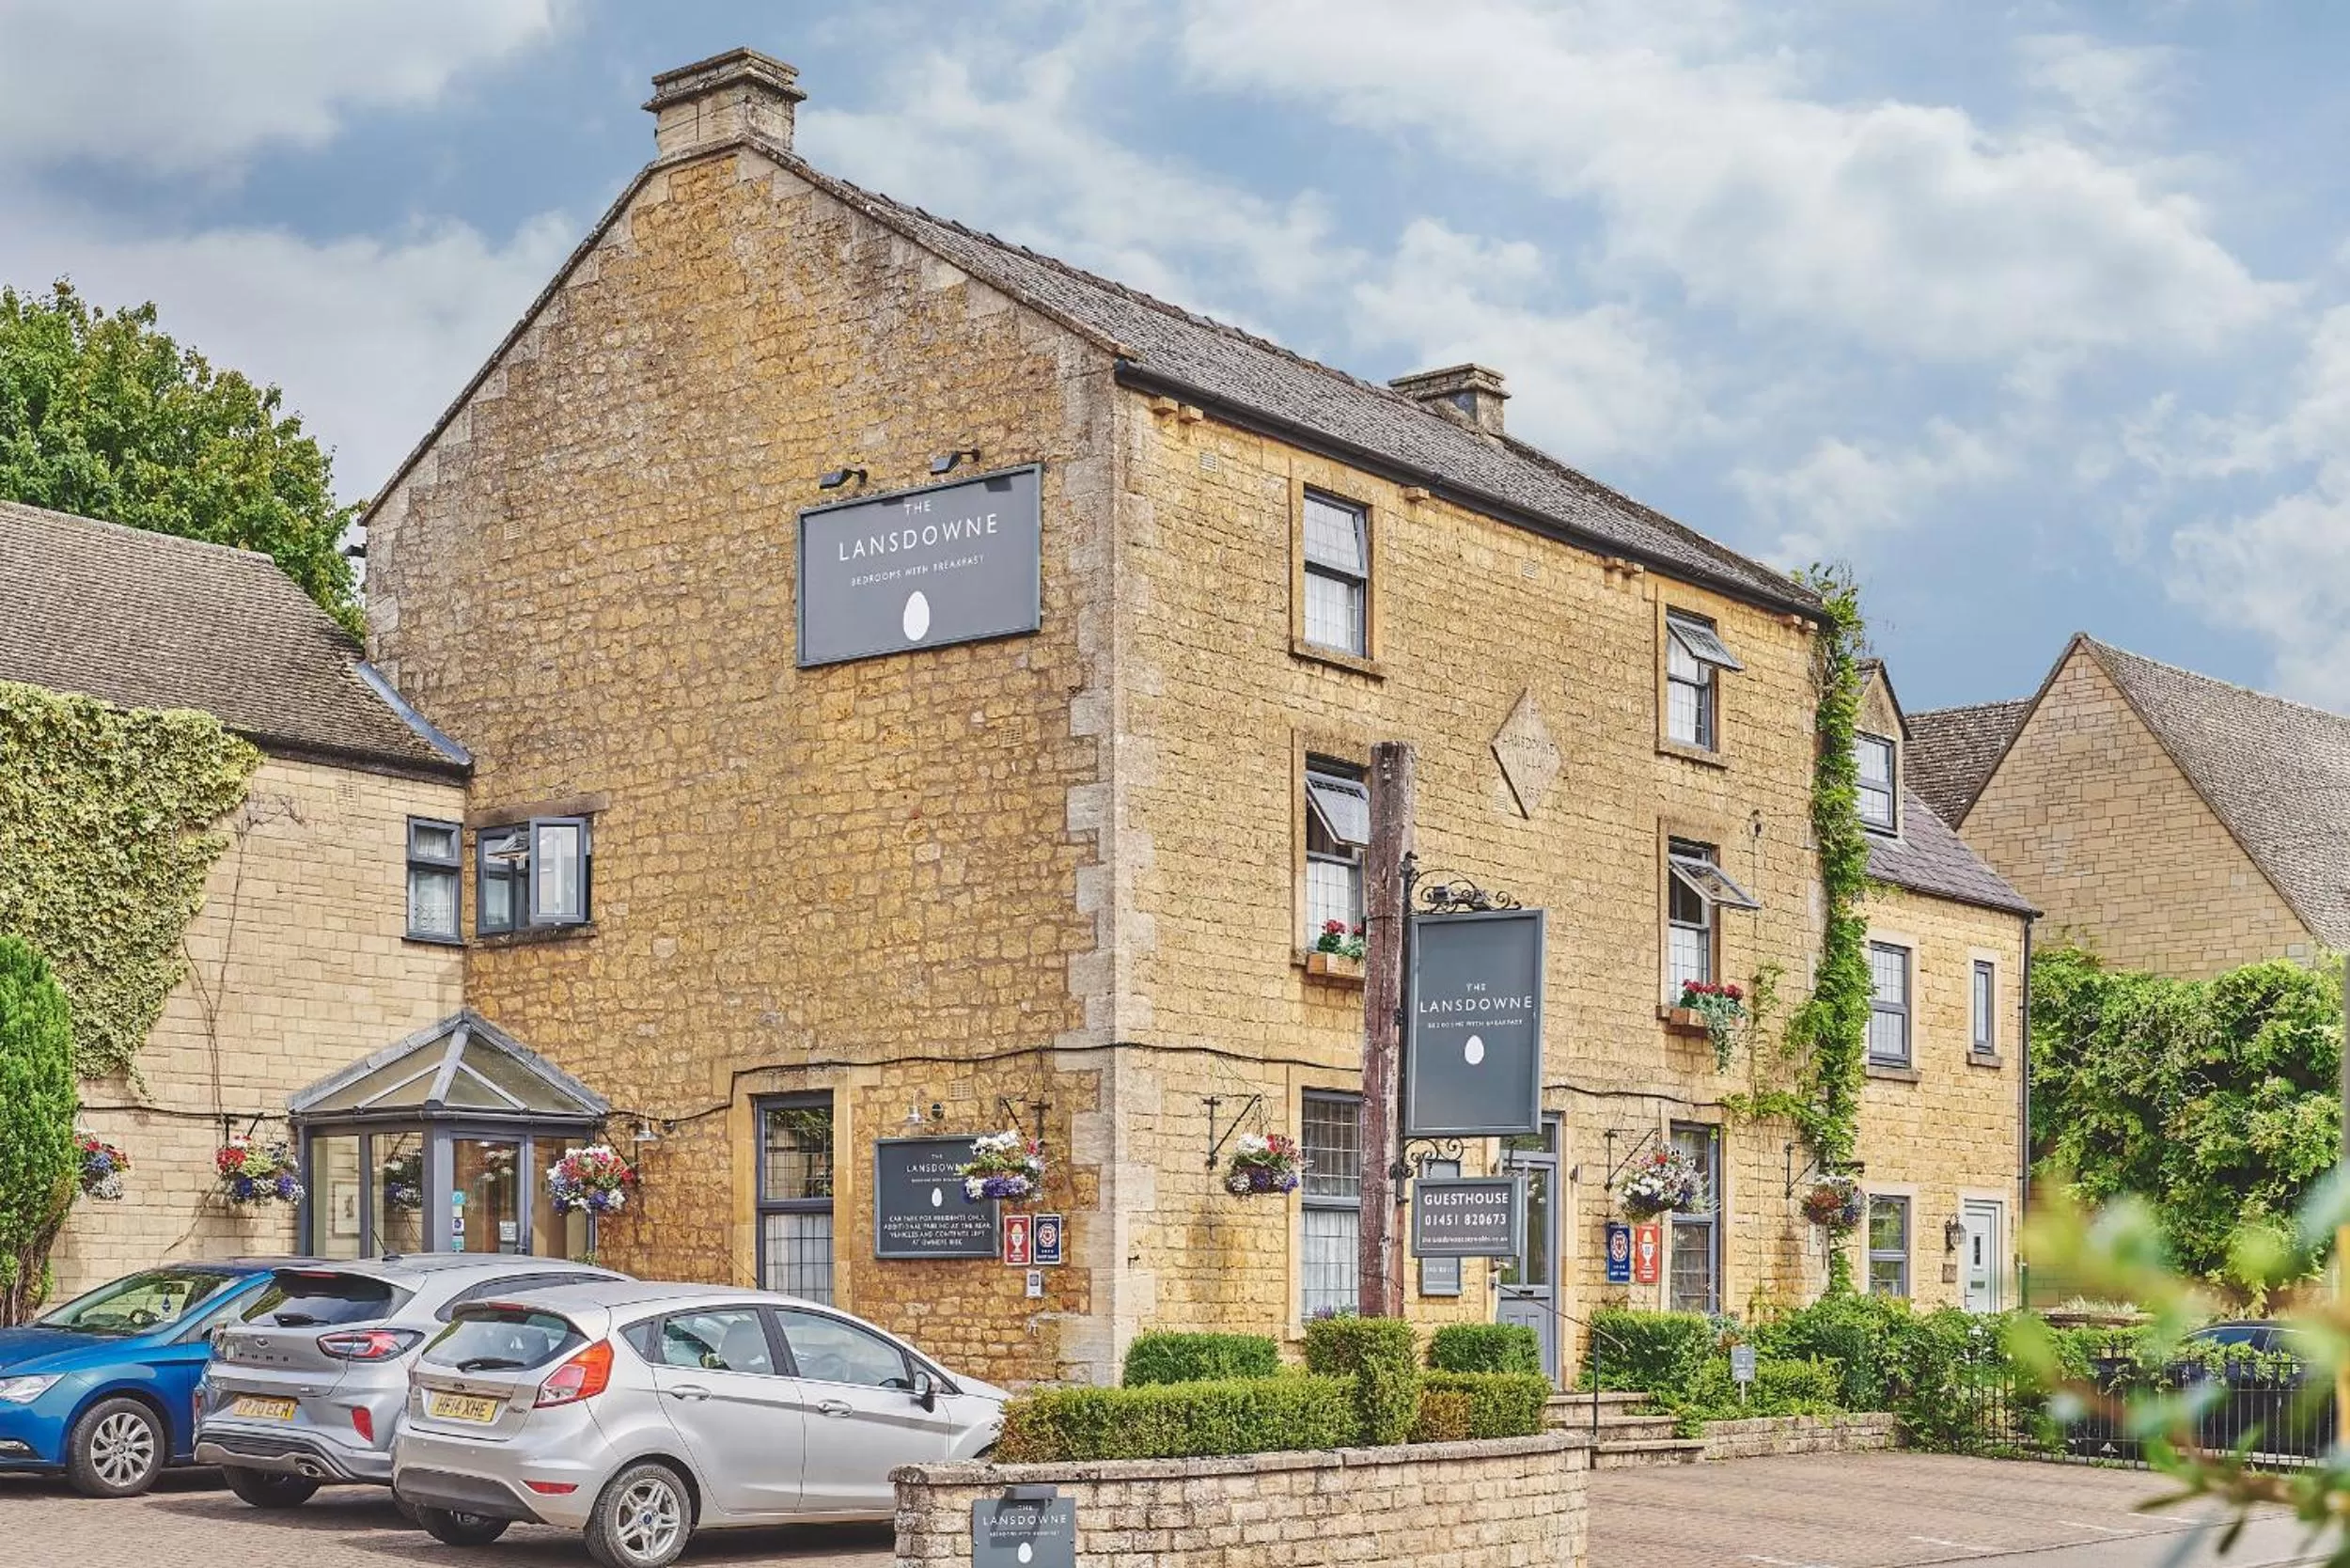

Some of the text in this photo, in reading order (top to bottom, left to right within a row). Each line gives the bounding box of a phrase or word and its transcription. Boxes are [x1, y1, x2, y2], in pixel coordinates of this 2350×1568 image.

[904, 500, 932, 516] THE
[838, 513, 998, 561] LANSDOWNE
[851, 556, 984, 587] BEDROOMS WITH BREAKFAST
[1420, 996, 1532, 1012] LANSDOWNE
[1424, 1193, 1509, 1205] GUESTHOUSE
[1425, 1214, 1506, 1226] 01451 820673
[462, 1400, 488, 1417] XHE
[982, 1514, 1067, 1526] LANSDOWNE
